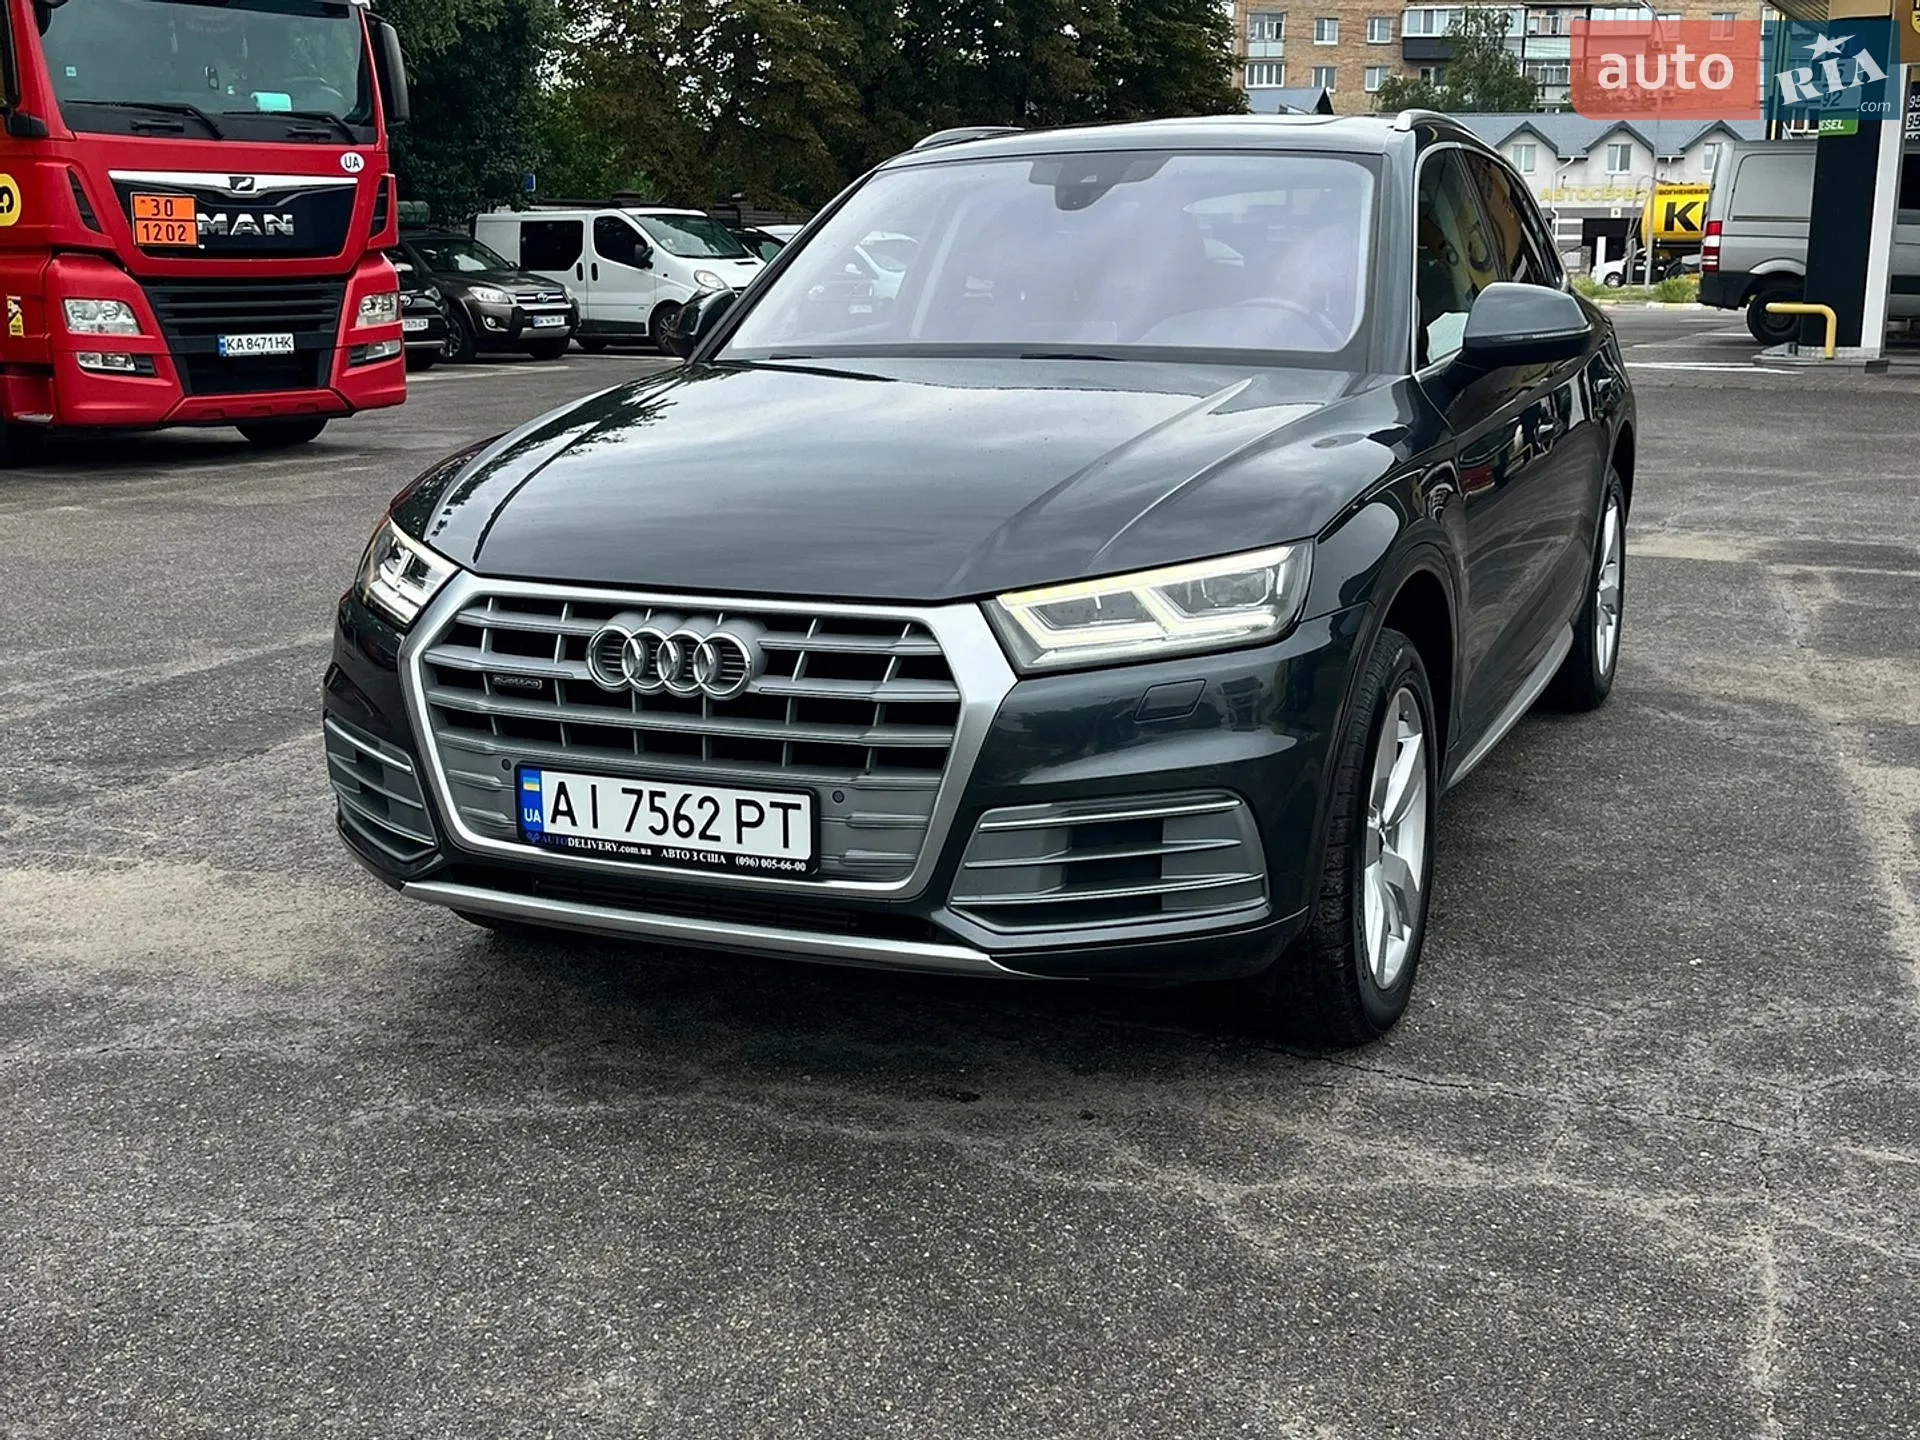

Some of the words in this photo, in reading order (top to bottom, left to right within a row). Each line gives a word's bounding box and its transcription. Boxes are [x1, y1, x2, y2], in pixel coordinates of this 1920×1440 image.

[343, 155, 361, 169] UA
[151, 198, 174, 218] 30
[142, 223, 187, 243] 1202
[197, 213, 295, 236] MAN
[523, 807, 542, 824] UA
[550, 781, 599, 830] AI
[621, 786, 721, 842] 7562
[735, 798, 802, 850] PT
[735, 854, 759, 868] (096)
